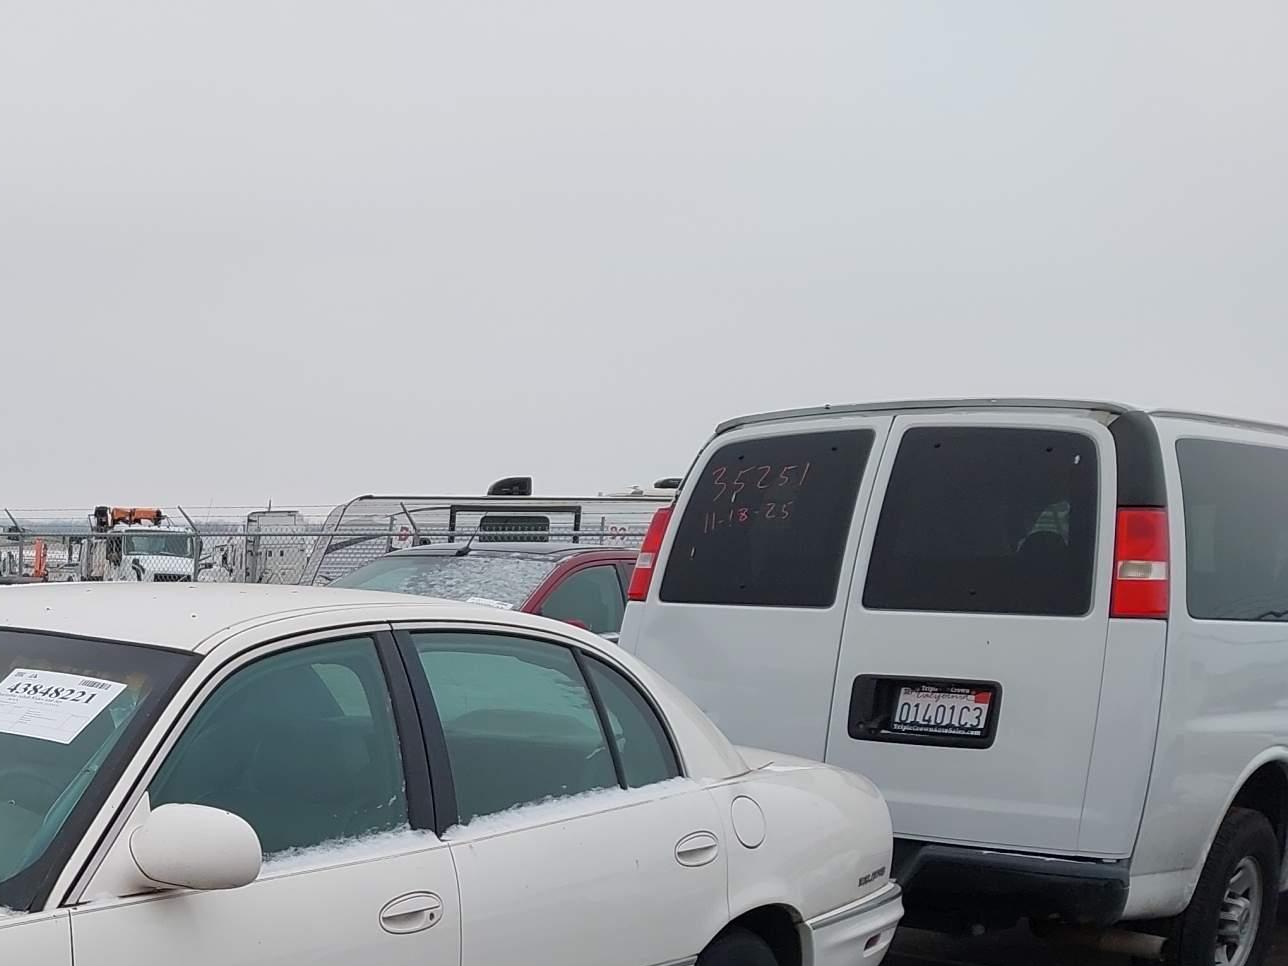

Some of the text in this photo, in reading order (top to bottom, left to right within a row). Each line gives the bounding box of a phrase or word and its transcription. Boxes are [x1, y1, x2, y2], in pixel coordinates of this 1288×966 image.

[712, 462, 810, 502] 35251
[7, 682, 97, 704] 43848221
[899, 702, 983, 728] 01401C3
